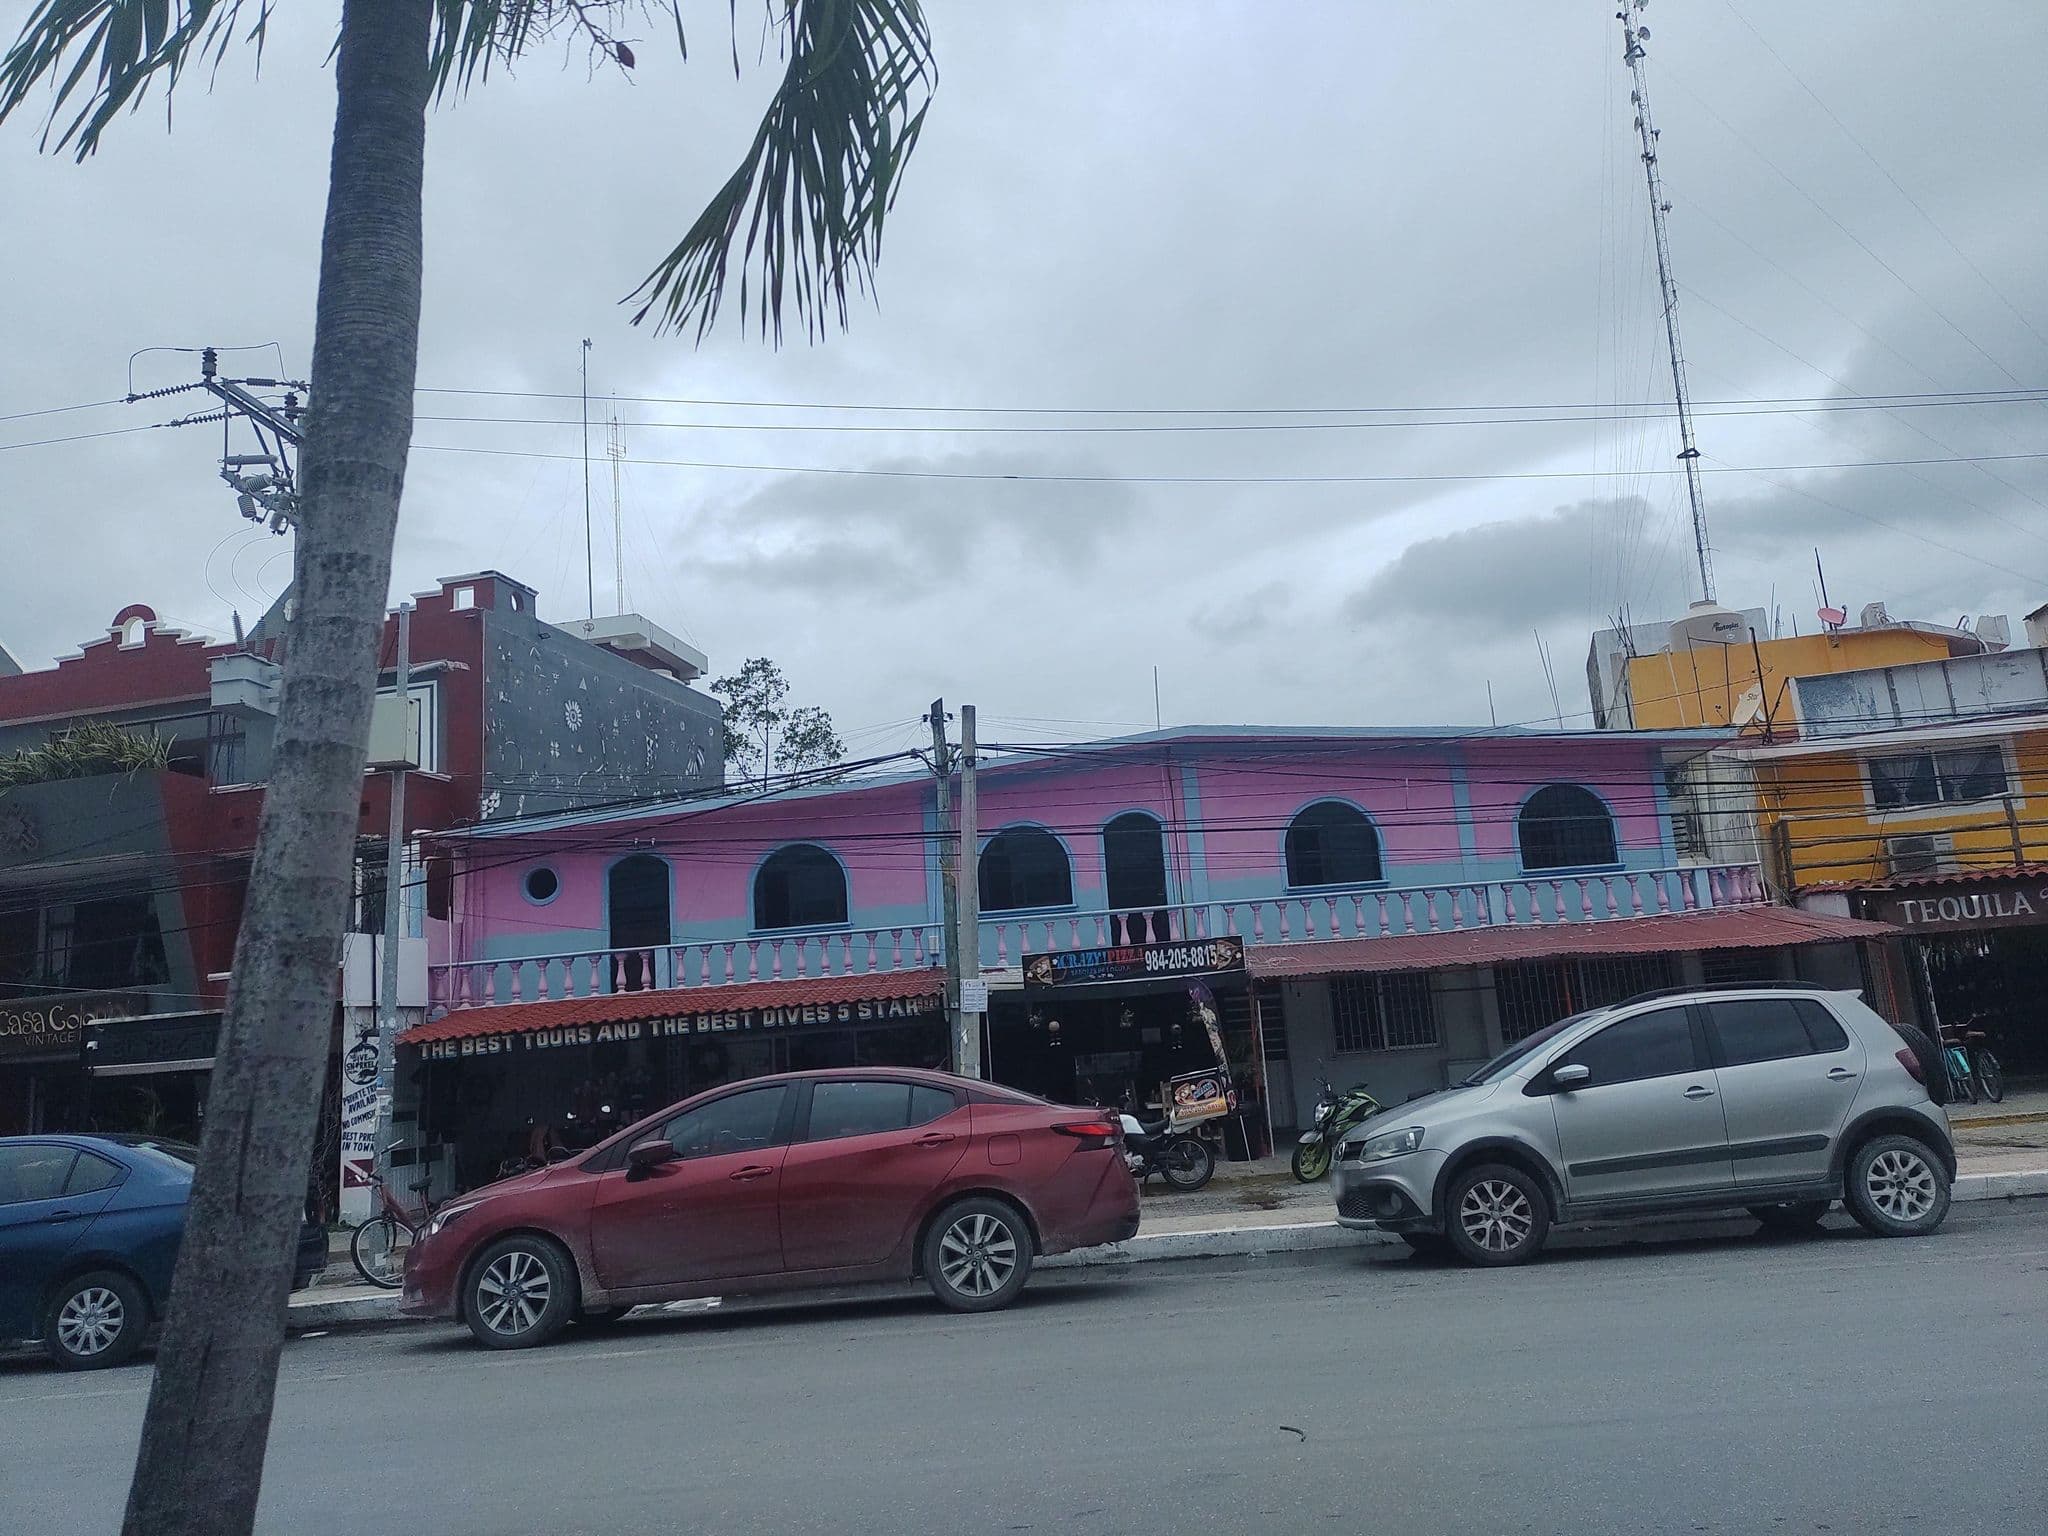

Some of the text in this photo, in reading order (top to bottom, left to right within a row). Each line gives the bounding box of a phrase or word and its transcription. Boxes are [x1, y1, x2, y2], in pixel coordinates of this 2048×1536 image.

[1897, 891, 2036, 924] TEQUILA
[1145, 944, 1217, 971] 984-205-8815
[418, 1041, 457, 1060] THE
[461, 1034, 514, 1057] BEST
[522, 1026, 592, 1050] TOURS
[597, 1021, 640, 1043] AND
[649, 1017, 690, 1037] THE
[697, 1011, 754, 1033] BEST
[763, 1005, 831, 1028] DIVES
[837, 1004, 850, 1022] 5
[858, 998, 921, 1019] STAR
[24, 1031, 77, 1046] VINTAGE
[342, 1119, 350, 1131] NO
[342, 1131, 358, 1141] BEST
[342, 1141, 351, 1151] IN
